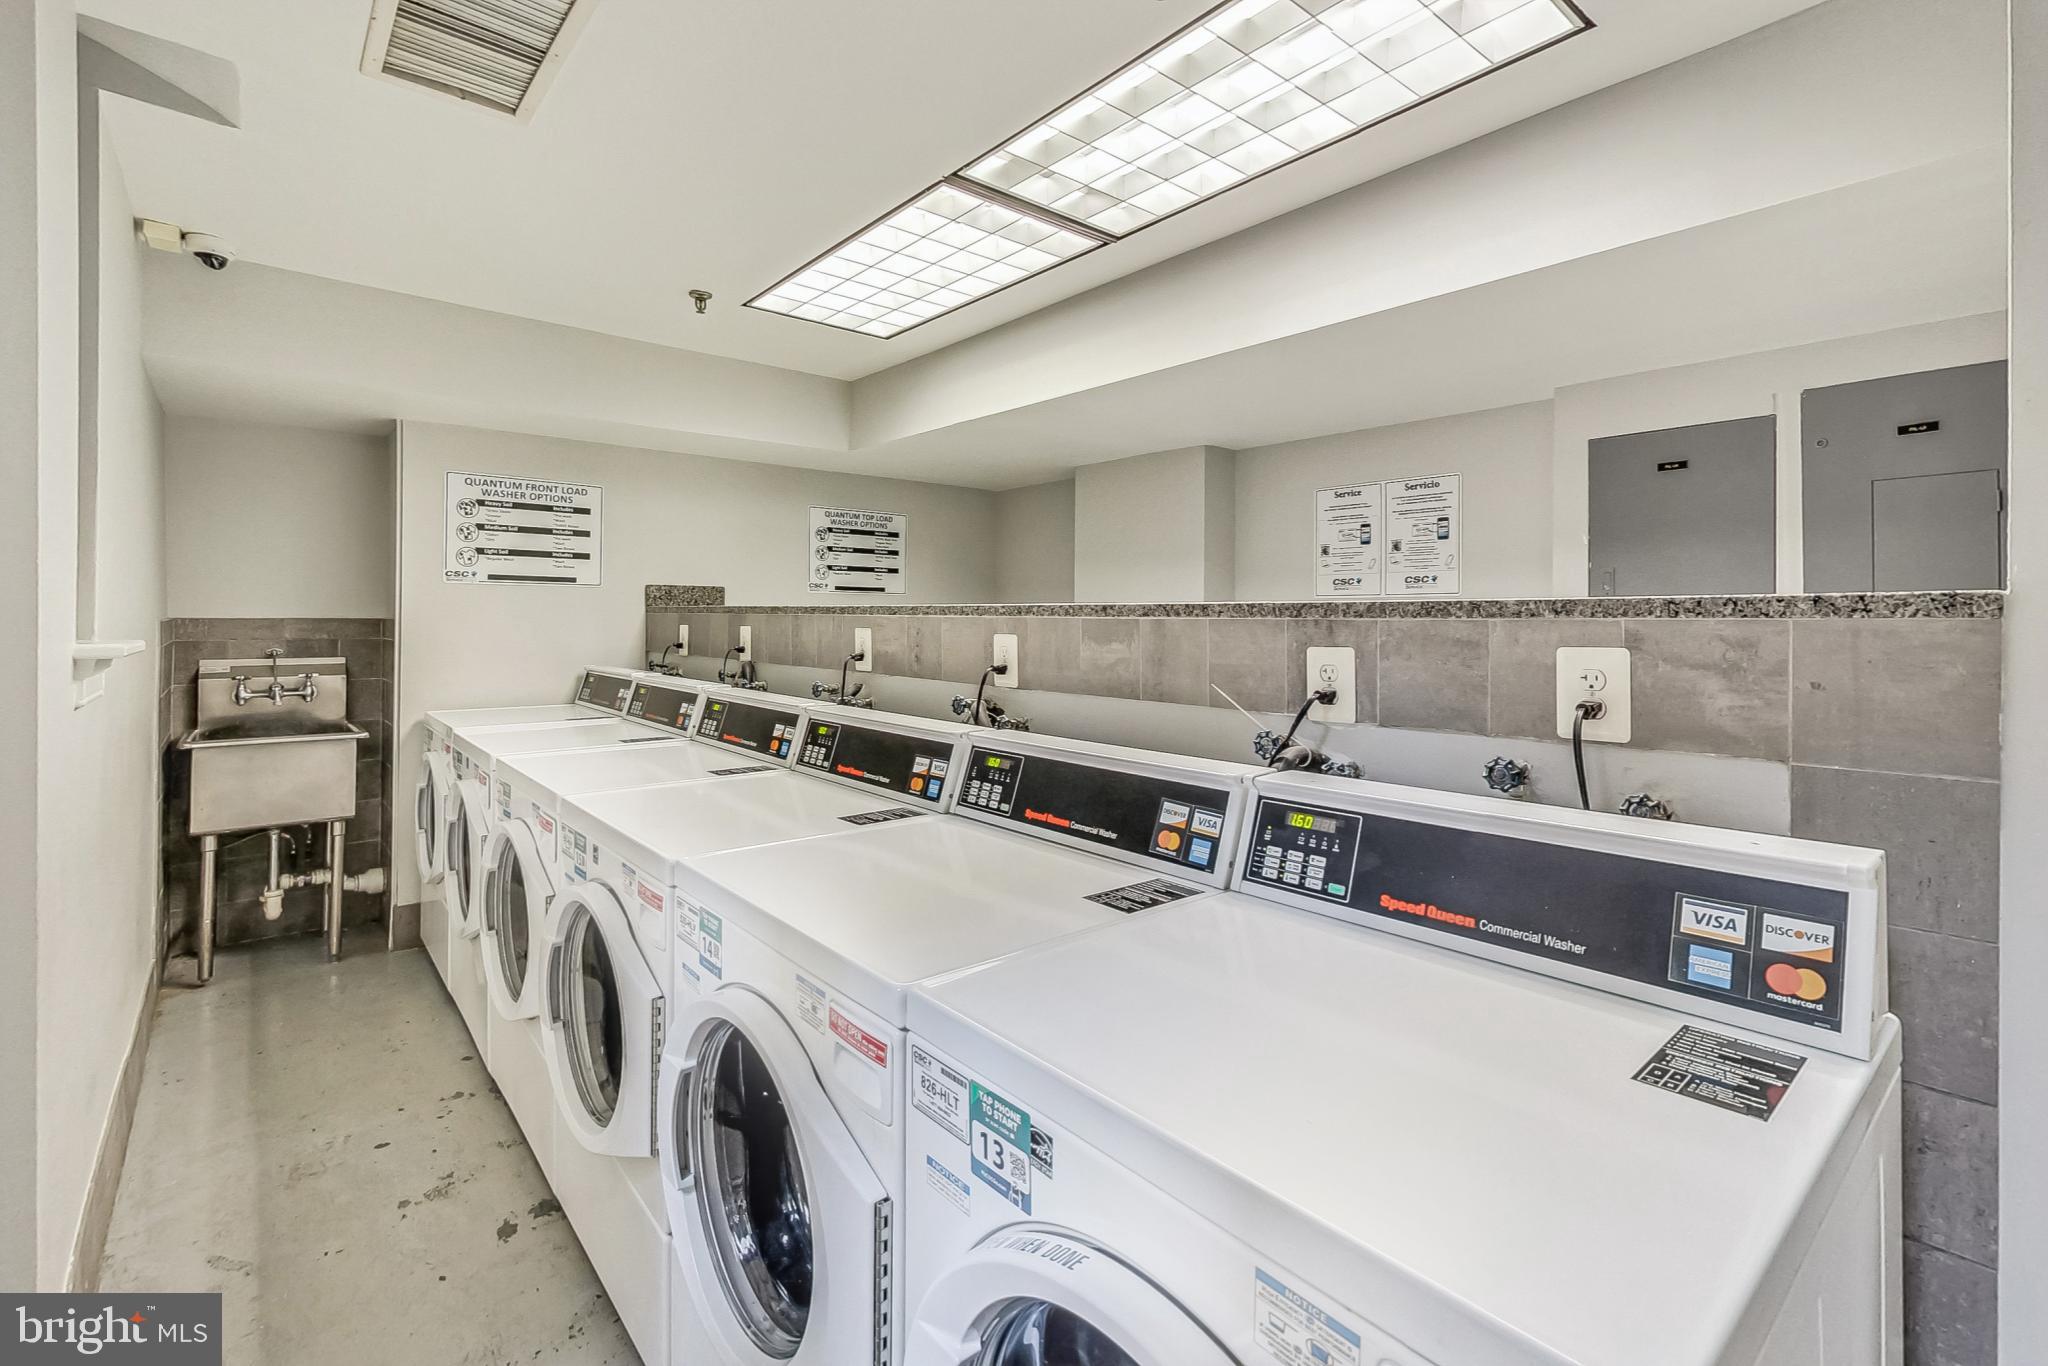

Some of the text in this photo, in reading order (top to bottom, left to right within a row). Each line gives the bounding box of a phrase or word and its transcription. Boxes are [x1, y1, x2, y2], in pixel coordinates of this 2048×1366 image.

[464, 477, 588, 496] QUANTUM FRONT LOAD
[1334, 490, 1362, 498] Service
[1404, 480, 1440, 491] Servicio
[481, 488, 573, 504] WASHER OPTIONS
[824, 511, 860, 520] QUANTUM
[876, 515, 893, 523] LOAD
[830, 519, 888, 529] WASHER OPTIONS
[1332, 578, 1355, 586] CSC
[1404, 576, 1430, 584] CSC
[1198, 816, 1218, 830] VISA
[1379, 894, 1586, 955] Speed Queen Commercial Washer
[1691, 910, 1737, 932] VISA
[1765, 924, 1830, 945] DISCOVER
[1766, 992, 1823, 1011] mastercard
[921, 1075, 960, 1111] 826-HLT
[978, 1090, 1022, 1125] TAP PHONE
[981, 1102, 993, 1116] TO
[993, 1109, 1018, 1132] START
[980, 1131, 1004, 1170] 13
[1041, 1243, 1090, 1271] DONE
[1284, 1288, 1329, 1323] NOTICE
